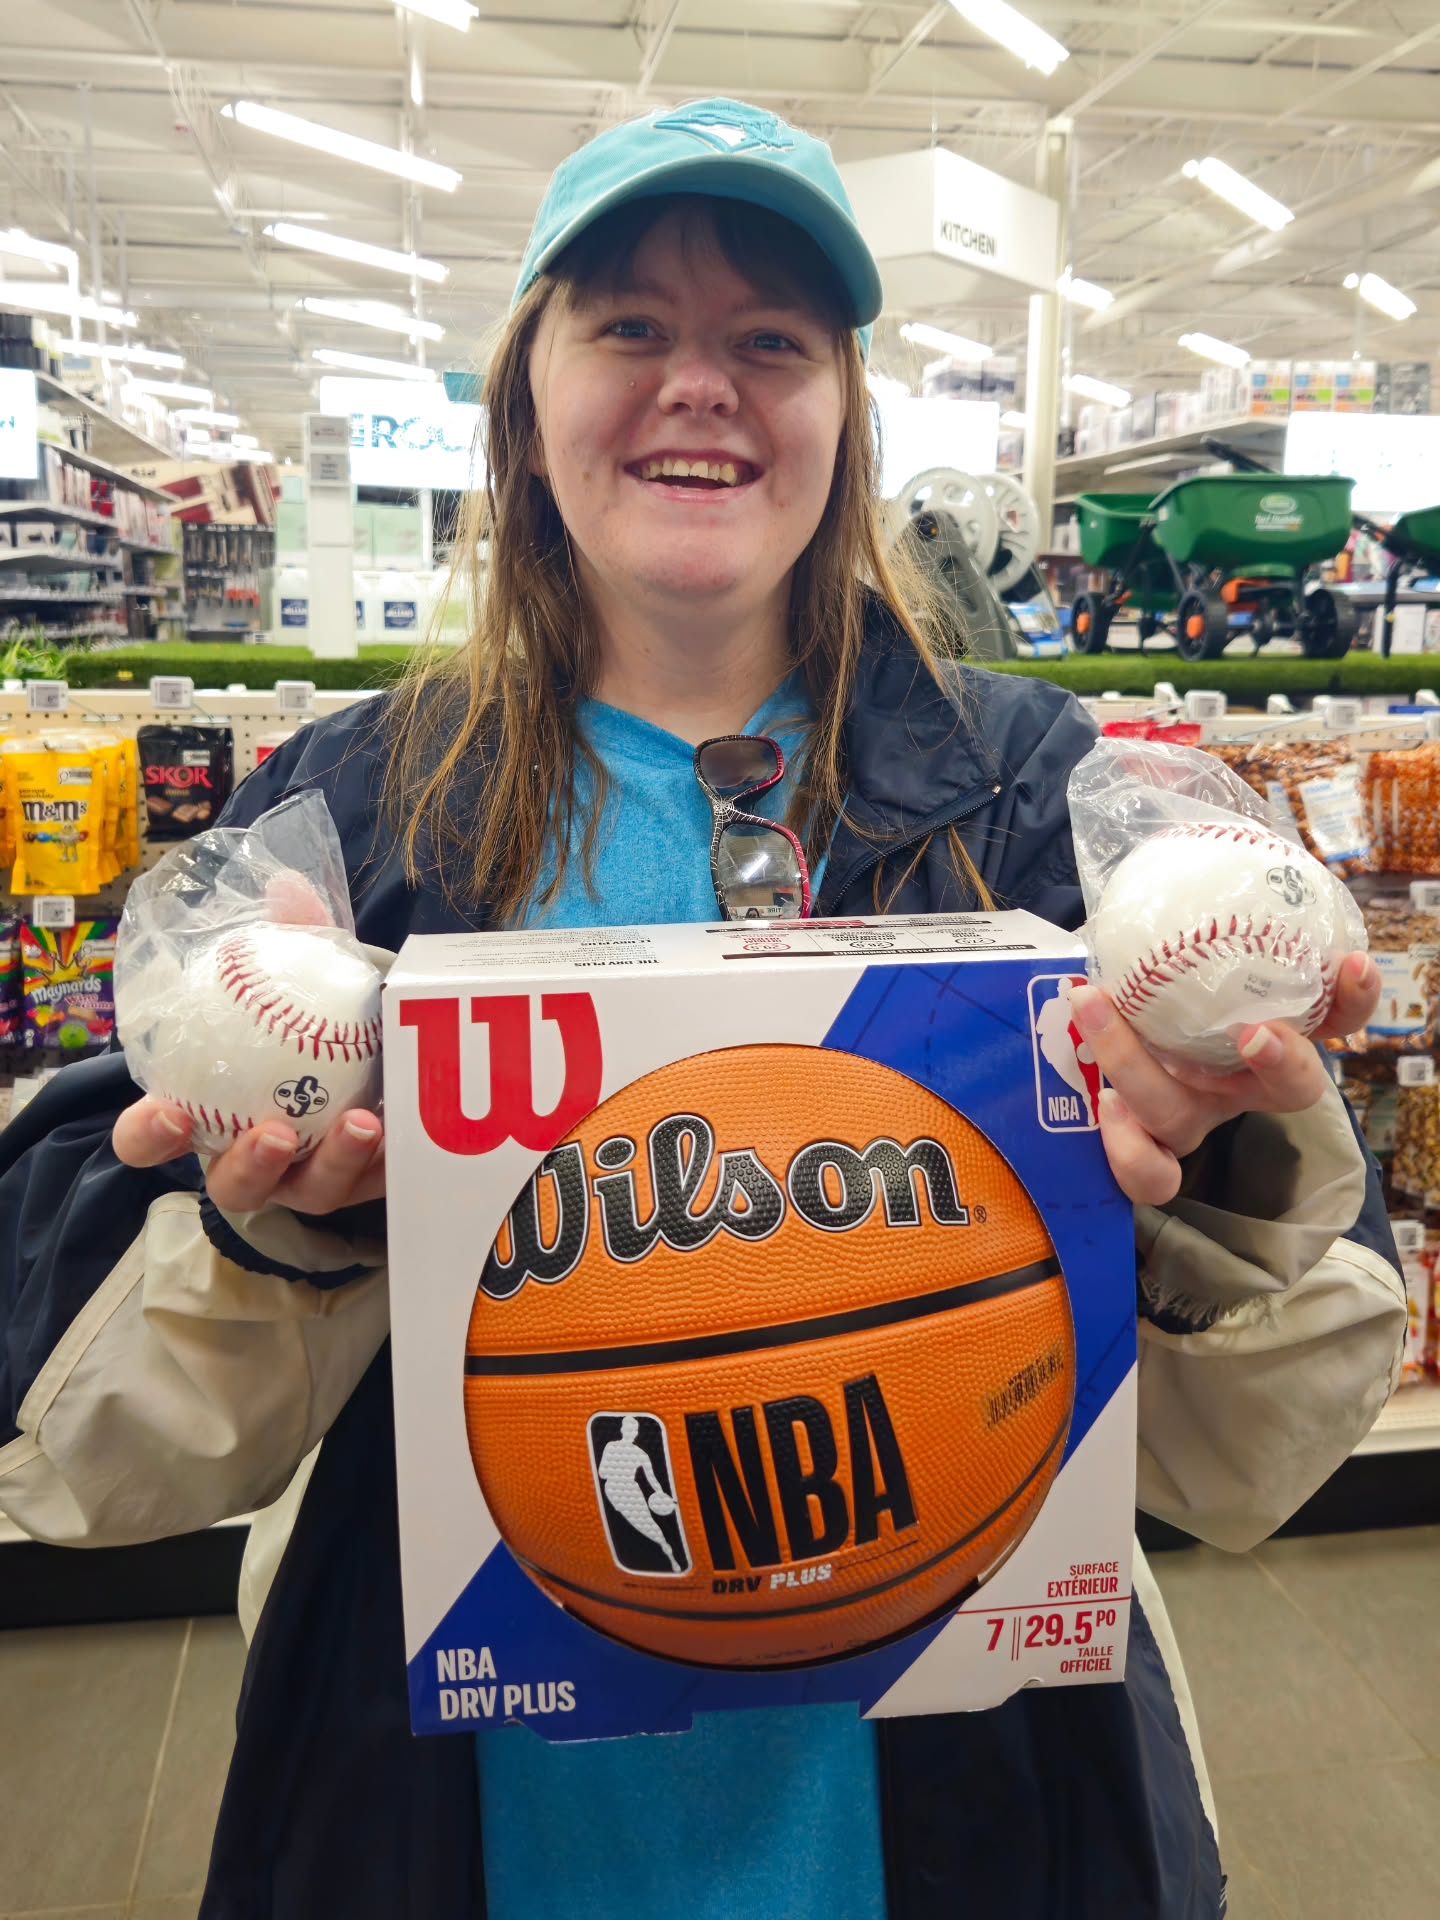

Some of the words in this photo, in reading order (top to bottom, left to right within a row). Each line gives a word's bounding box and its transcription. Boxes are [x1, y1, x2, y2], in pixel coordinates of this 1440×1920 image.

[940, 221, 996, 257] KITCHEN
[145, 766, 213, 788] SKOR
[1048, 1095, 1080, 1122] NBA
[480, 1112, 971, 1300] Wilson
[684, 1371, 919, 1572] NBA
[712, 1576, 762, 1595] DRV
[769, 1563, 833, 1590] PLUS
[1069, 1561, 1119, 1576] SURFACE
[1048, 1576, 1118, 1598] EXTÉRIEUR
[987, 1618, 1004, 1651] 7
[1024, 1611, 1093, 1648] 29.5
[436, 1646, 497, 1683] NBA
[1060, 1658, 1112, 1673] OFFICIEL
[1078, 1646, 1114, 1657] TAILLE
[439, 1686, 497, 1721] DRV
[503, 1680, 576, 1716] PLUS
